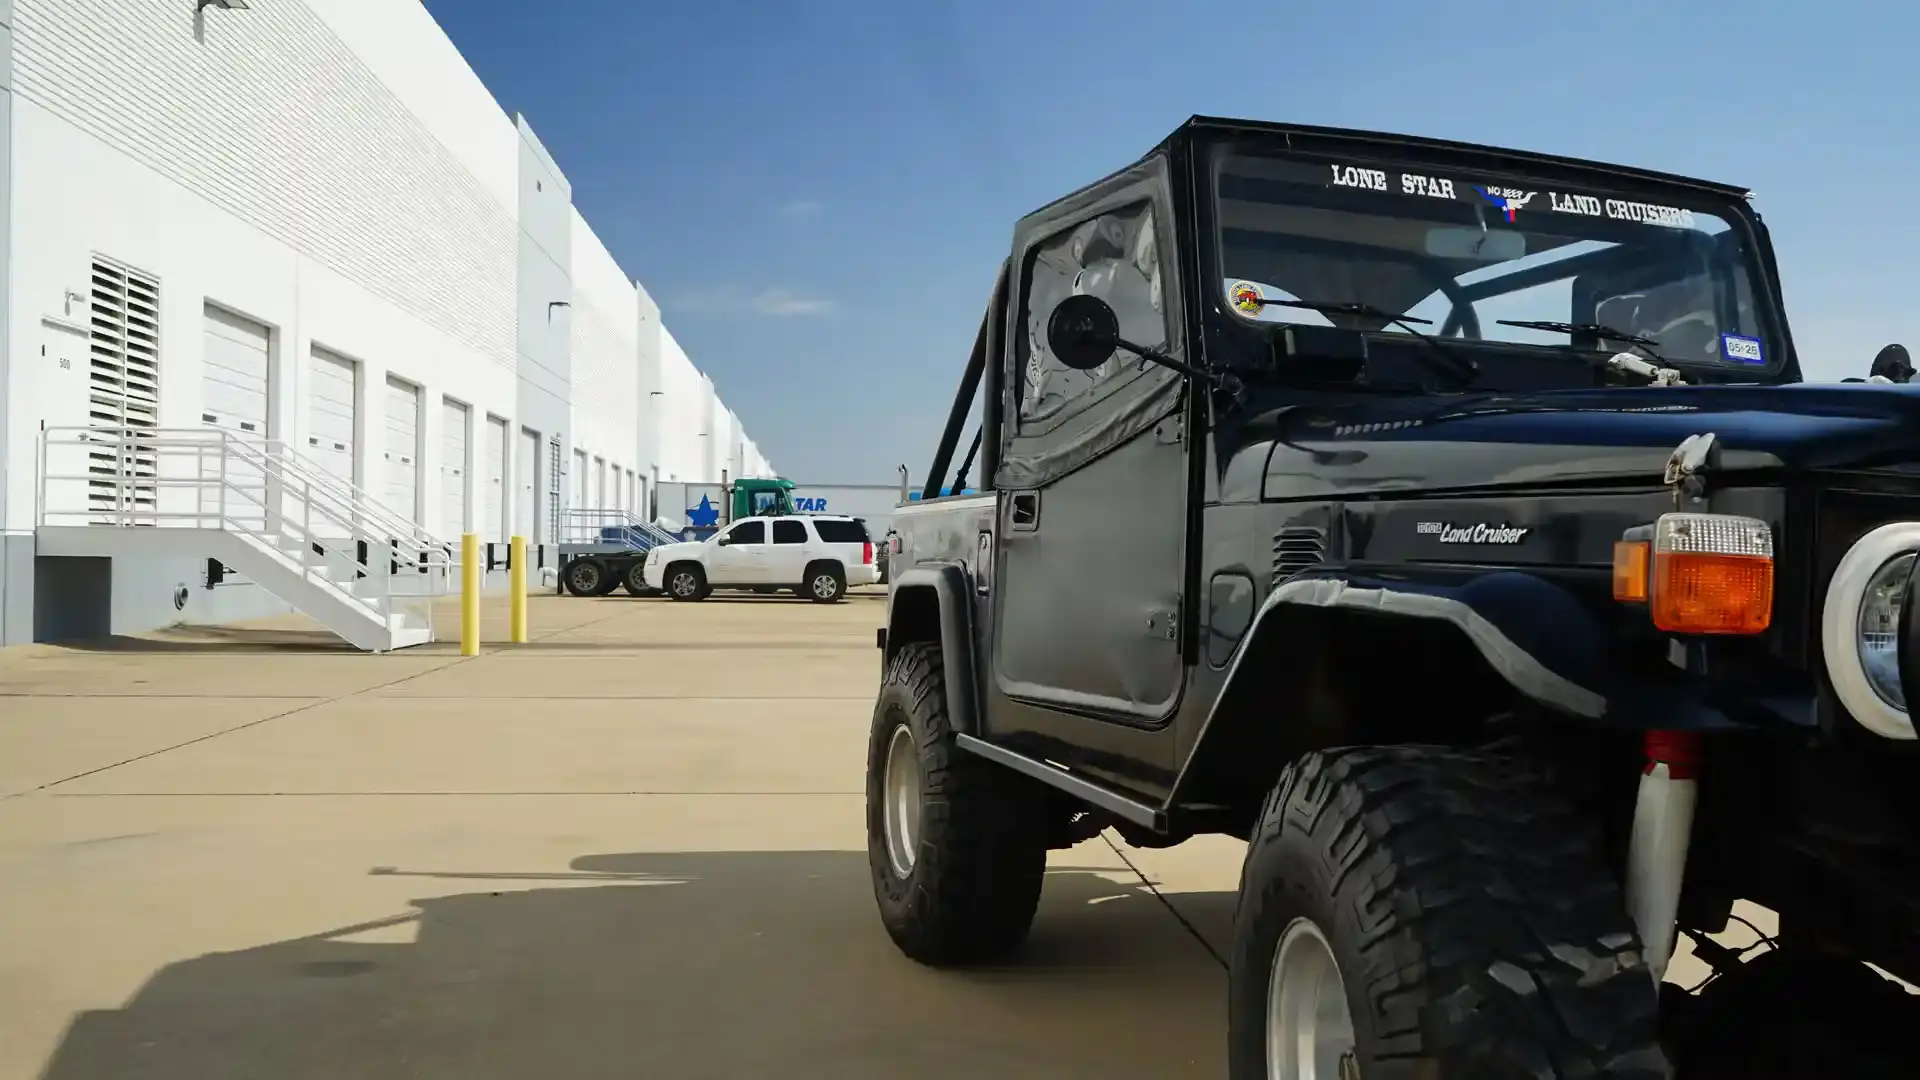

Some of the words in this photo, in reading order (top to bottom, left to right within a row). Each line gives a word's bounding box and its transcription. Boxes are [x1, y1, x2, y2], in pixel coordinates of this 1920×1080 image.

[1331, 165, 1387, 191] LONE
[1401, 173, 1456, 200] STAR
[1487, 186, 1500, 196] NO
[1502, 189, 1523, 199] JEEP
[1549, 192, 1600, 216] LAND
[1605, 199, 1695, 227] CRUISERS
[794, 498, 827, 511] TAR
[1440, 524, 1474, 543] Land
[1473, 523, 1527, 543] Cruiser
